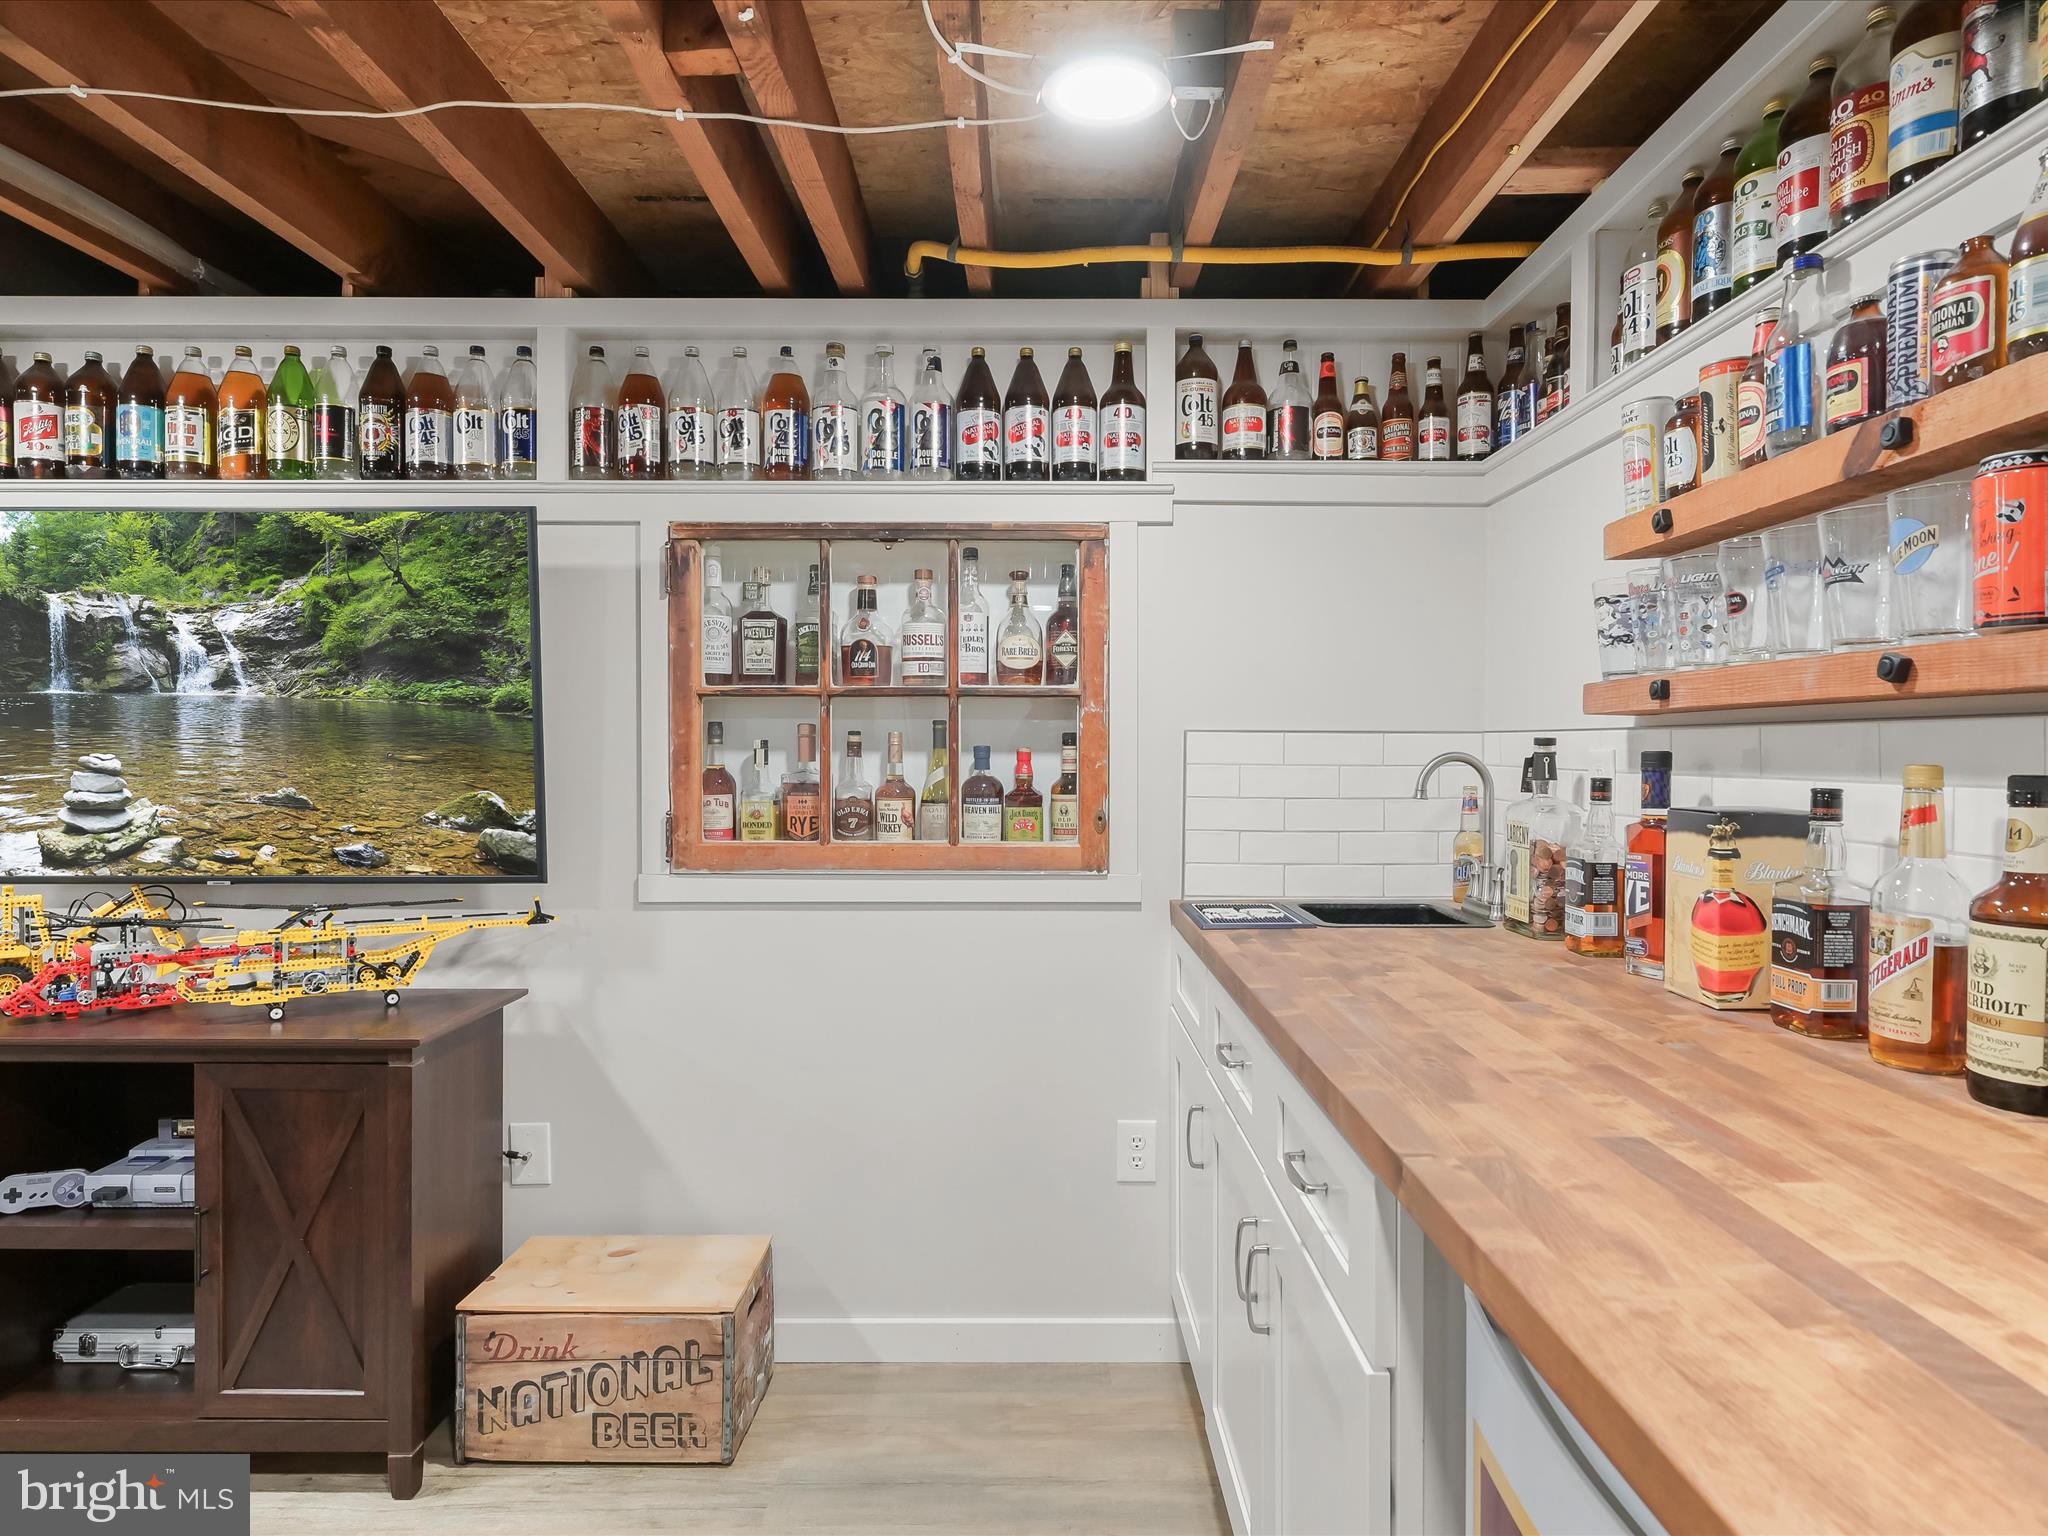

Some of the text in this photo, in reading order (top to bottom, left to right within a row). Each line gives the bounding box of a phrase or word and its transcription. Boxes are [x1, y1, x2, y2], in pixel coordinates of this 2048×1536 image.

[1859, 90, 1885, 105] 40
[1829, 99, 1854, 127] 40
[1830, 131, 1854, 157] OLDE
[1623, 290, 1644, 319] olt
[1931, 300, 1975, 324] TIONAL
[1931, 315, 1965, 336] HEMIAN
[1887, 282, 1898, 391] NATIONAL
[1898, 277, 1919, 396] PREMIUM
[1181, 393, 1214, 417] Colt
[1113, 407, 1132, 419] 40
[1739, 407, 1759, 419] ONAL
[410, 416, 436, 434] Colt
[457, 411, 484, 434] Colt
[502, 410, 529, 433] Colt
[770, 412, 798, 433] Col
[1011, 419, 1040, 433] NATIOAL
[1225, 417, 1258, 425] NATNAL
[513, 428, 530, 440] 45
[965, 421, 995, 435] NATINAL
[1060, 430, 1088, 439] NATINAL
[1383, 422, 1410, 434] NATIONAL
[1460, 425, 1488, 433] NATONAL
[168, 435, 195, 447] LIE
[420, 431, 440, 446] 45
[773, 447, 798, 457] DOULE
[871, 449, 898, 460] DOULE
[917, 448, 943, 458] DOULE
[1667, 454, 1683, 467] 45
[1892, 527, 1937, 564] UE MOON
[1680, 571, 1719, 584] LIGHT
[744, 627, 775, 640] PIKESVILLE
[902, 633, 944, 646] RUSSELL'S
[1001, 644, 1039, 656] RARE BREED
[854, 651, 871, 663] 114
[919, 663, 929, 673] 10
[713, 797, 730, 808] TUB
[837, 806, 851, 816] OLD
[964, 806, 1001, 815] HEAVEN HILL
[1009, 809, 1023, 822] Jack
[742, 821, 773, 829] BONDED
[848, 817, 859, 829] 7
[879, 813, 898, 824] WILD
[790, 815, 819, 836] RYE
[877, 822, 902, 834] TURKEY
[1507, 822, 1530, 846] LARCENY
[1672, 855, 1705, 877] Blanton's
[1626, 869, 1650, 881] MORE
[1772, 973, 1808, 996] FULL PROOF
[1970, 979, 1994, 997] OLD
[1986, 1034, 2021, 1049] WHISKEY
[484, 1331, 579, 1360] Drink
[477, 1339, 713, 1435] NATIONAL
[592, 1412, 708, 1449] BEER
